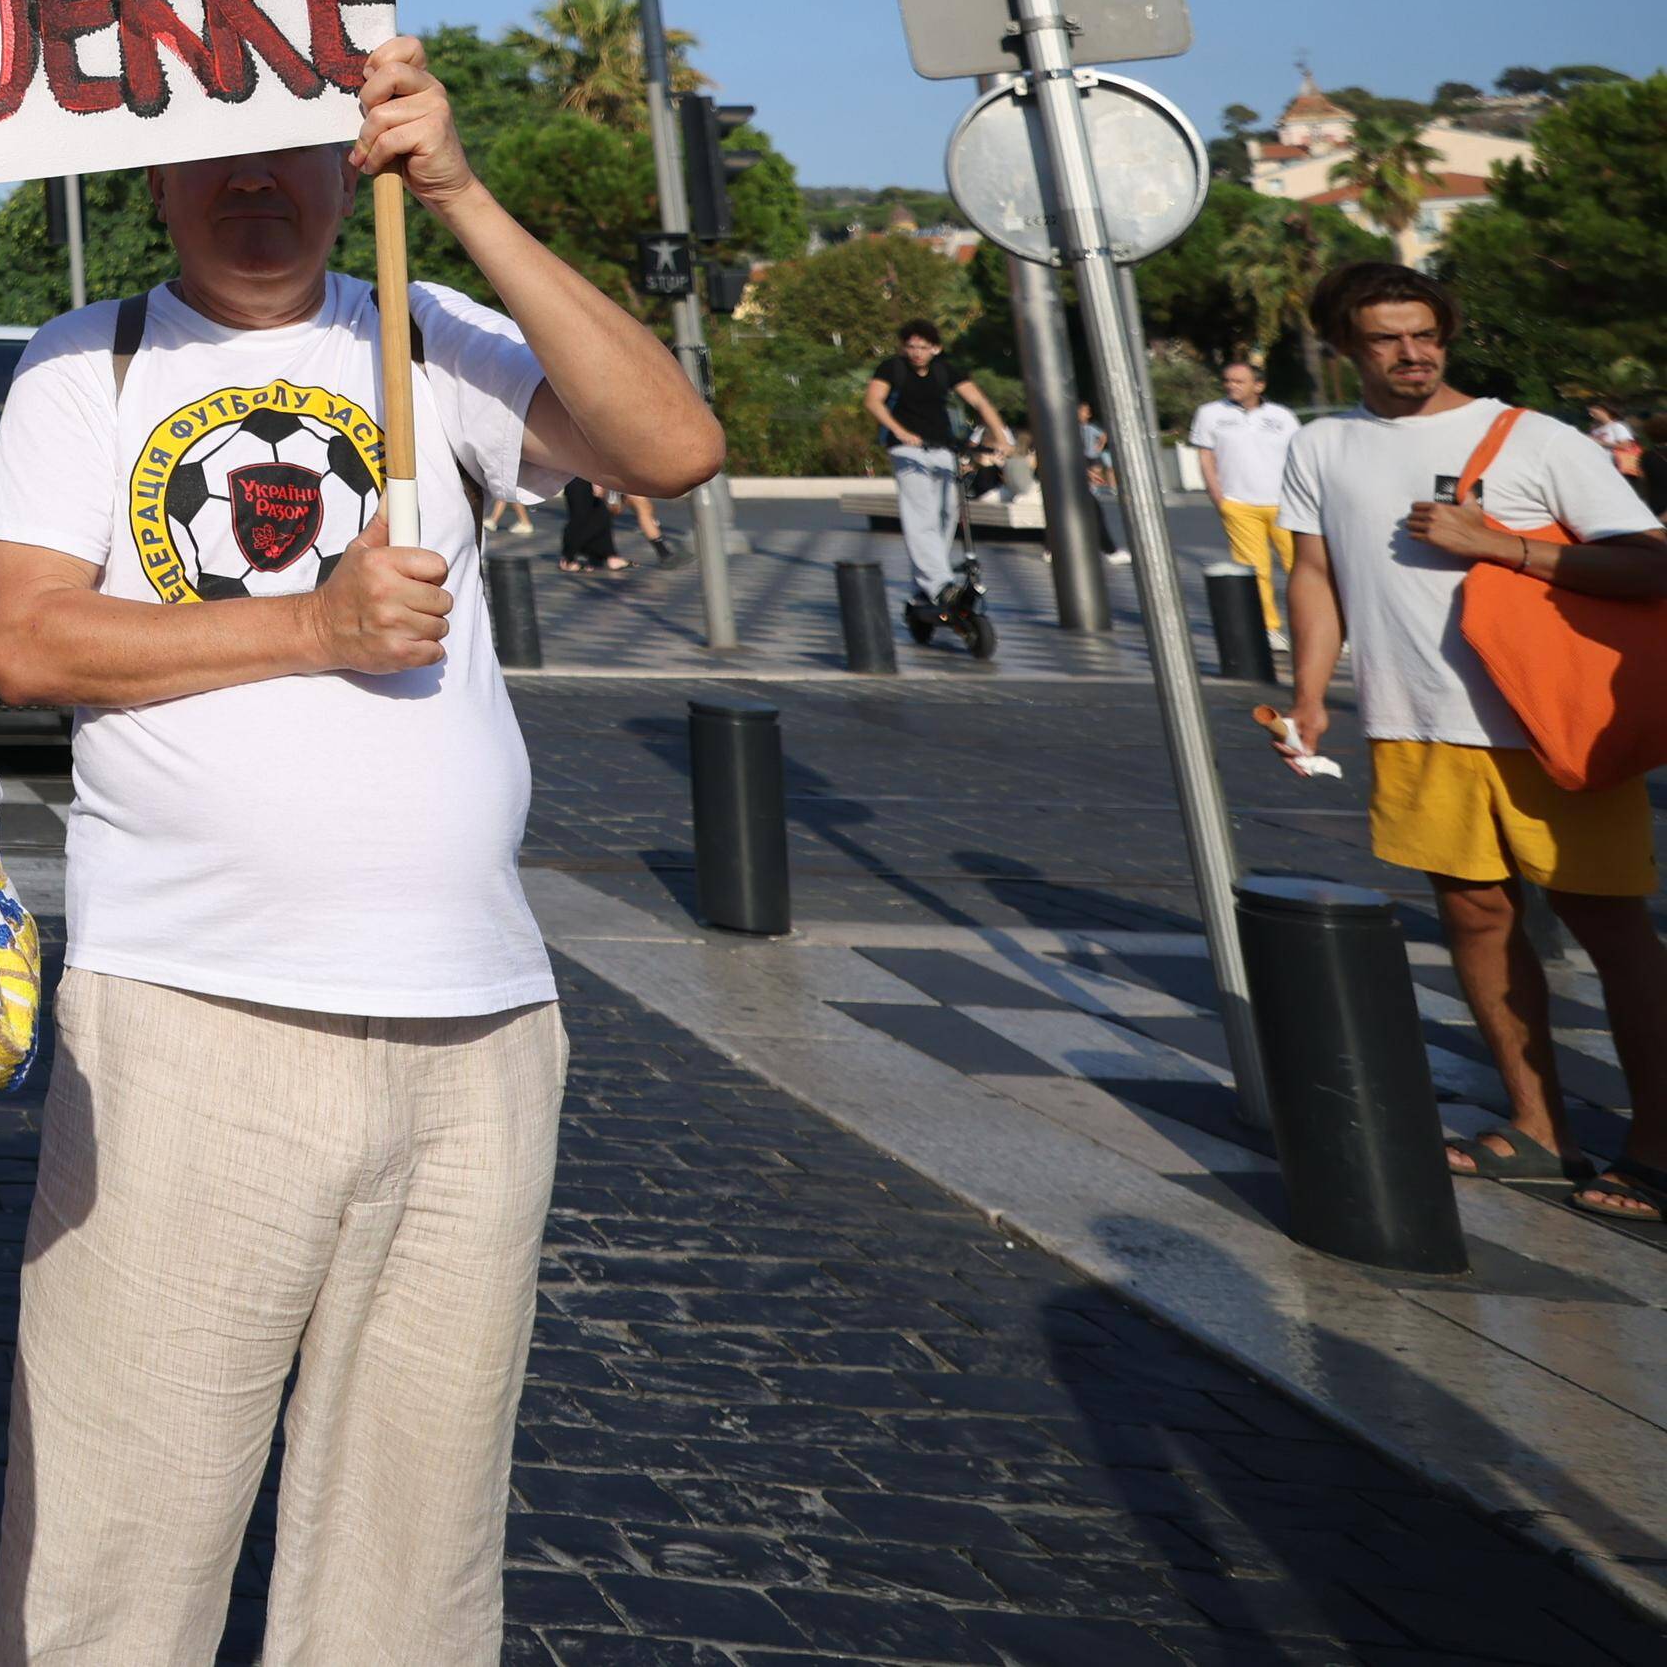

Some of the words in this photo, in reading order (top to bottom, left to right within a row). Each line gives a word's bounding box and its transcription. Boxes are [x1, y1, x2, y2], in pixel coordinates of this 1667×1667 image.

[137, 447, 187, 604] ЕДЕРАЦІЯ
[169, 384, 312, 440] ФУТБОЛУ
[324, 400, 387, 484] АСН
